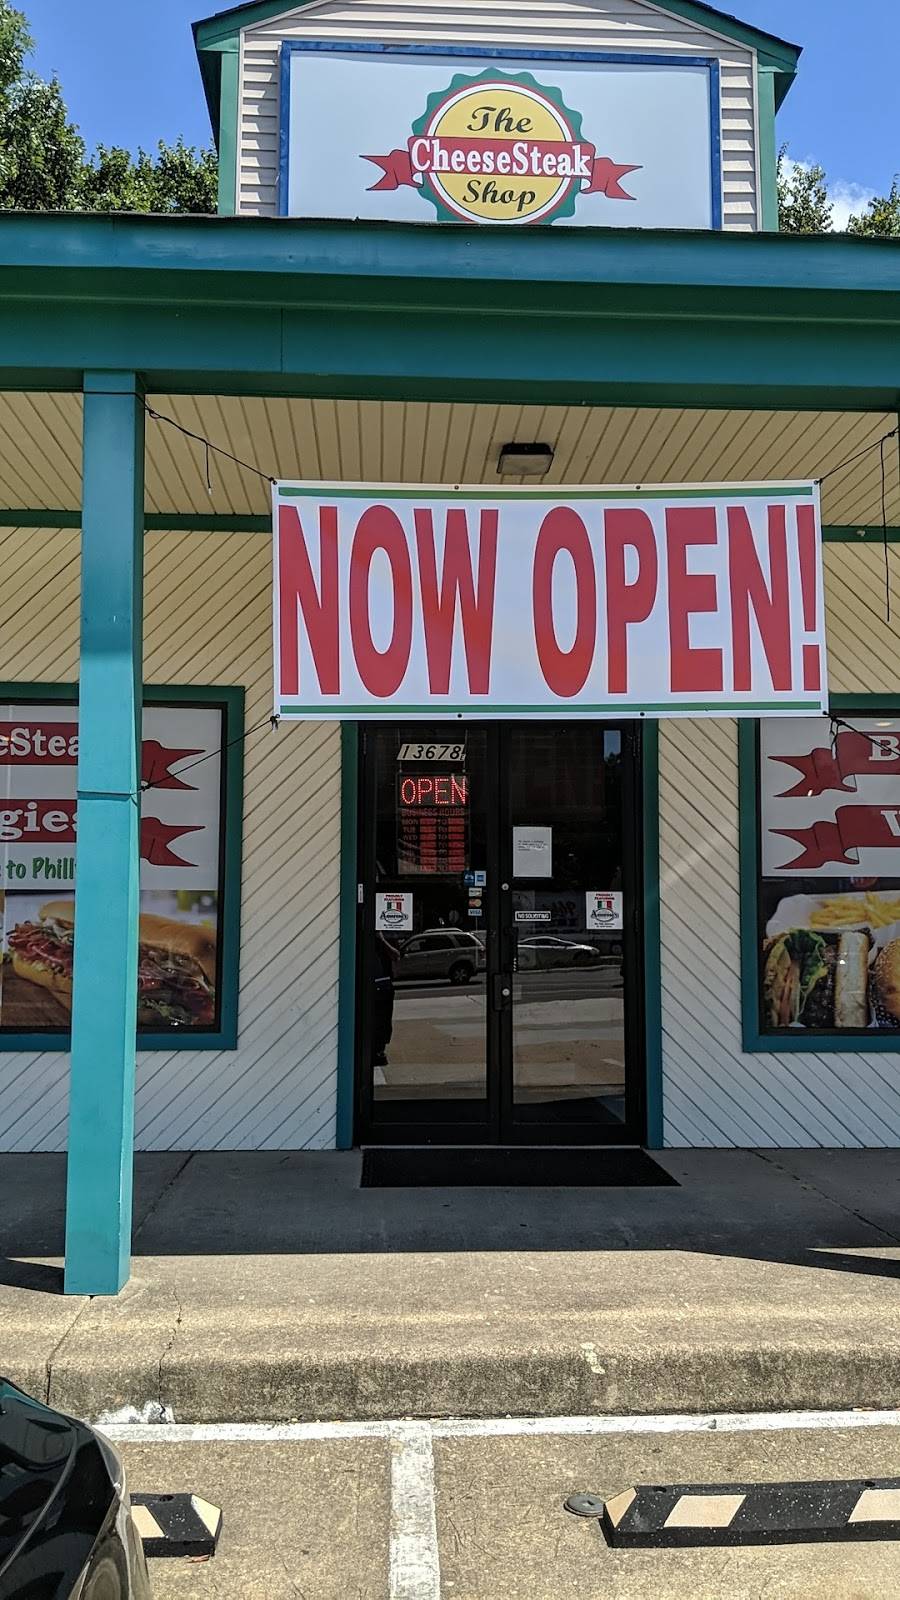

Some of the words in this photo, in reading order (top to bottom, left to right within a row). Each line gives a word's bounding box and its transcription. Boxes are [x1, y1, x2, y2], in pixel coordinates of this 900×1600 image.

[467, 106, 533, 134] The
[410, 137, 593, 177] CheeseSteak
[462, 179, 536, 212] Shop
[277, 504, 500, 698] NOW
[532, 503, 823, 698] OPEN!
[402, 745, 462, 760] 13678
[401, 777, 467, 804] OPEN
[0, 801, 77, 841] gie
[6, 859, 27, 880] to
[32, 856, 77, 880] Phill
